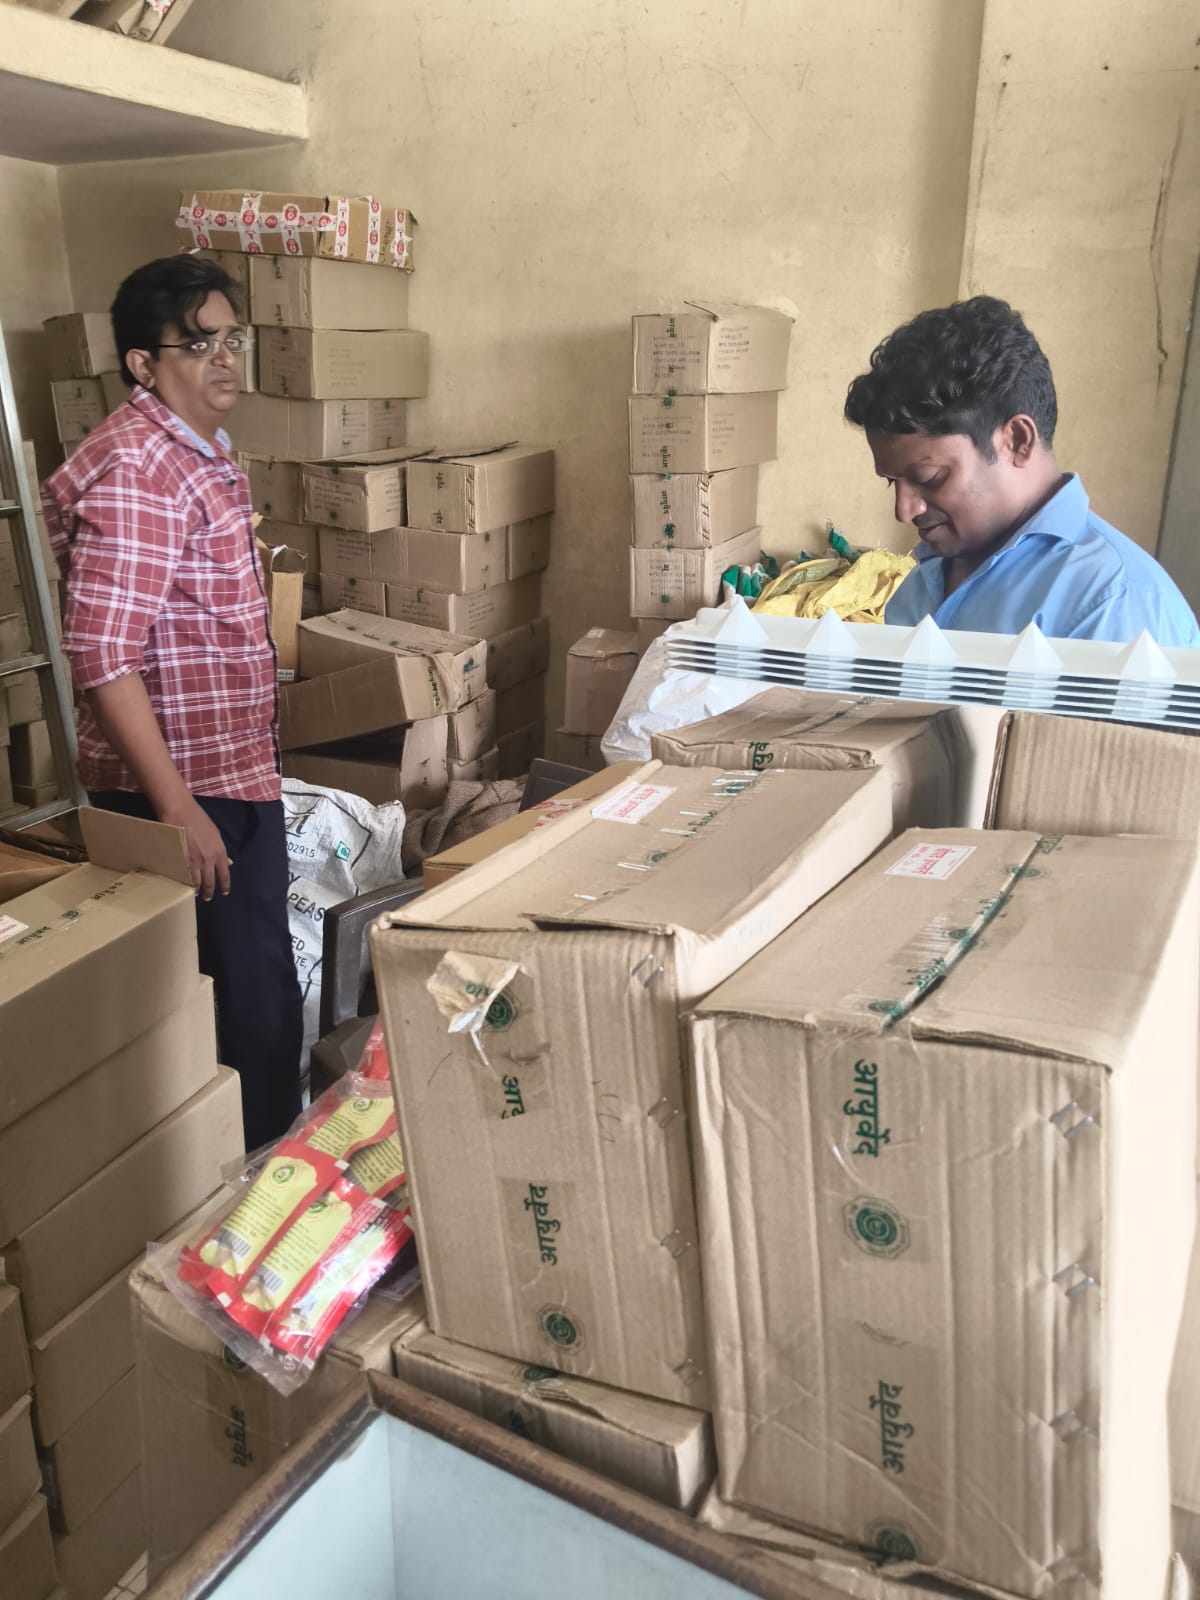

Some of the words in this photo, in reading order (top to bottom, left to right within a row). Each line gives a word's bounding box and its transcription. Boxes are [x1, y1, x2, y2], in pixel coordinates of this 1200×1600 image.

[288, 892, 326, 922] PEAS
[843, 1058, 891, 1158] आयुर्वेद
[524, 1183, 561, 1266] आयुर्वेद
[869, 1379, 914, 1475] आयुर्वेद
